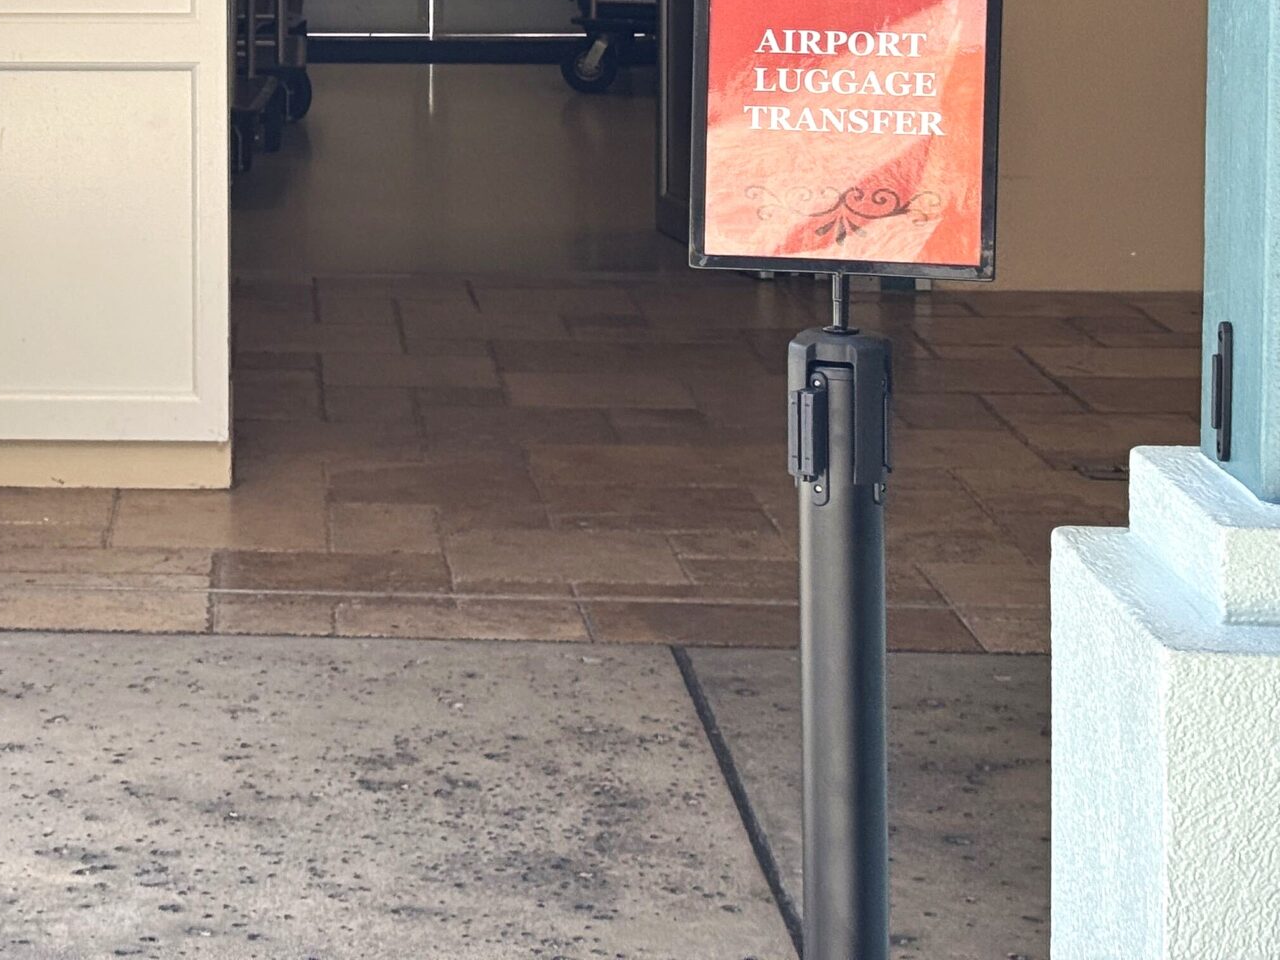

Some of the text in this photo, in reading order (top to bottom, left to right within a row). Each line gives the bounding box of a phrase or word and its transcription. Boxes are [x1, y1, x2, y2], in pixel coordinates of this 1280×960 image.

[754, 28, 927, 58] AIRPORT
[753, 67, 937, 97] LUGGAGE
[743, 105, 945, 136] TRANSFER
